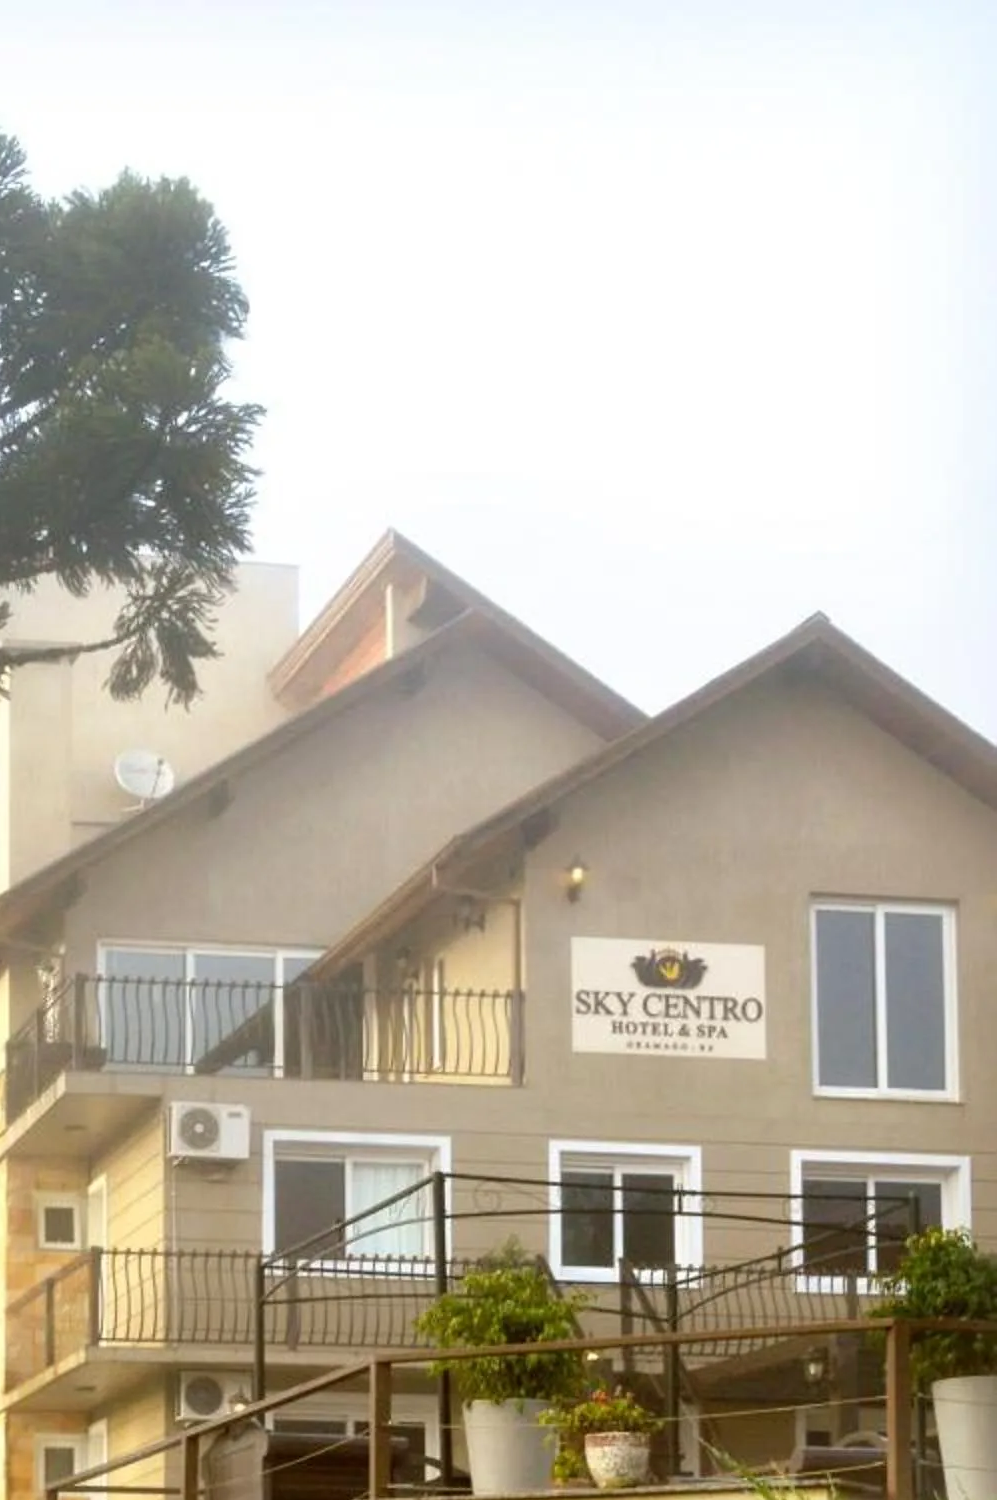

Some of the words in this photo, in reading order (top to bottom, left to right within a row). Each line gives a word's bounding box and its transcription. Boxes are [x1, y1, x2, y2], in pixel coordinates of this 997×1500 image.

[575, 989, 635, 1017] SKY
[642, 992, 763, 1023] CENTRO
[611, 1020, 673, 1036] HOTEL
[678, 1024, 691, 1037] &
[696, 1024, 728, 1039] SPA
